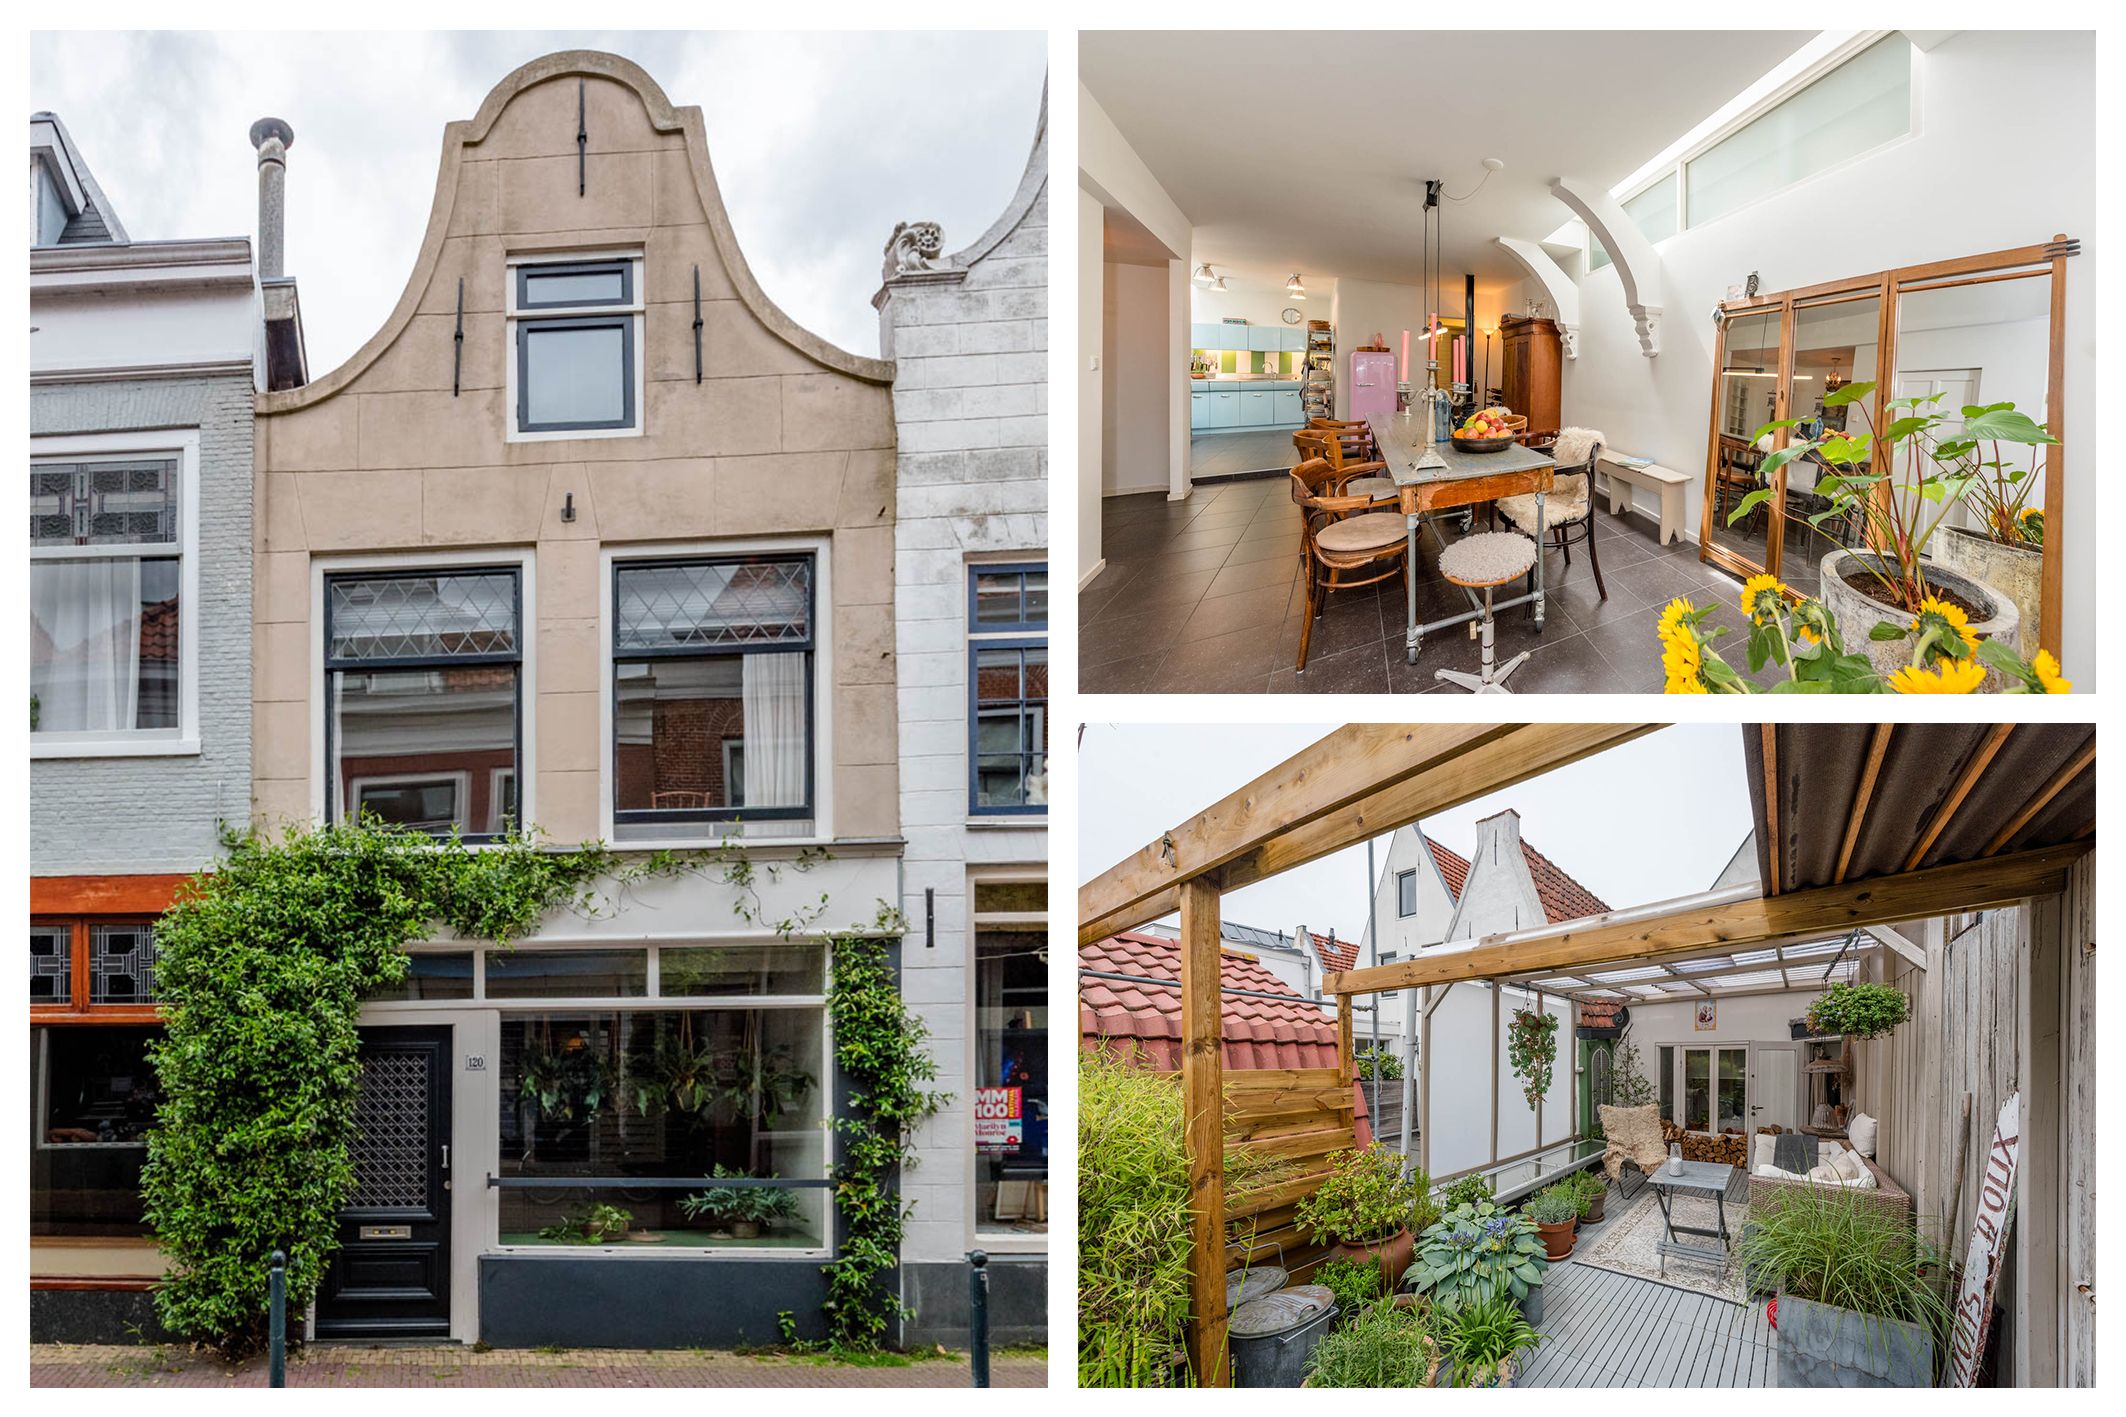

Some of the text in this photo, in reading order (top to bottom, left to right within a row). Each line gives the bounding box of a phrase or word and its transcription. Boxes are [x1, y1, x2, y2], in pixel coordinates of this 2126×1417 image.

[468, 1057, 484, 1067] 120
[976, 1089, 1008, 1103] MM
[976, 1104, 1008, 1118] 100
